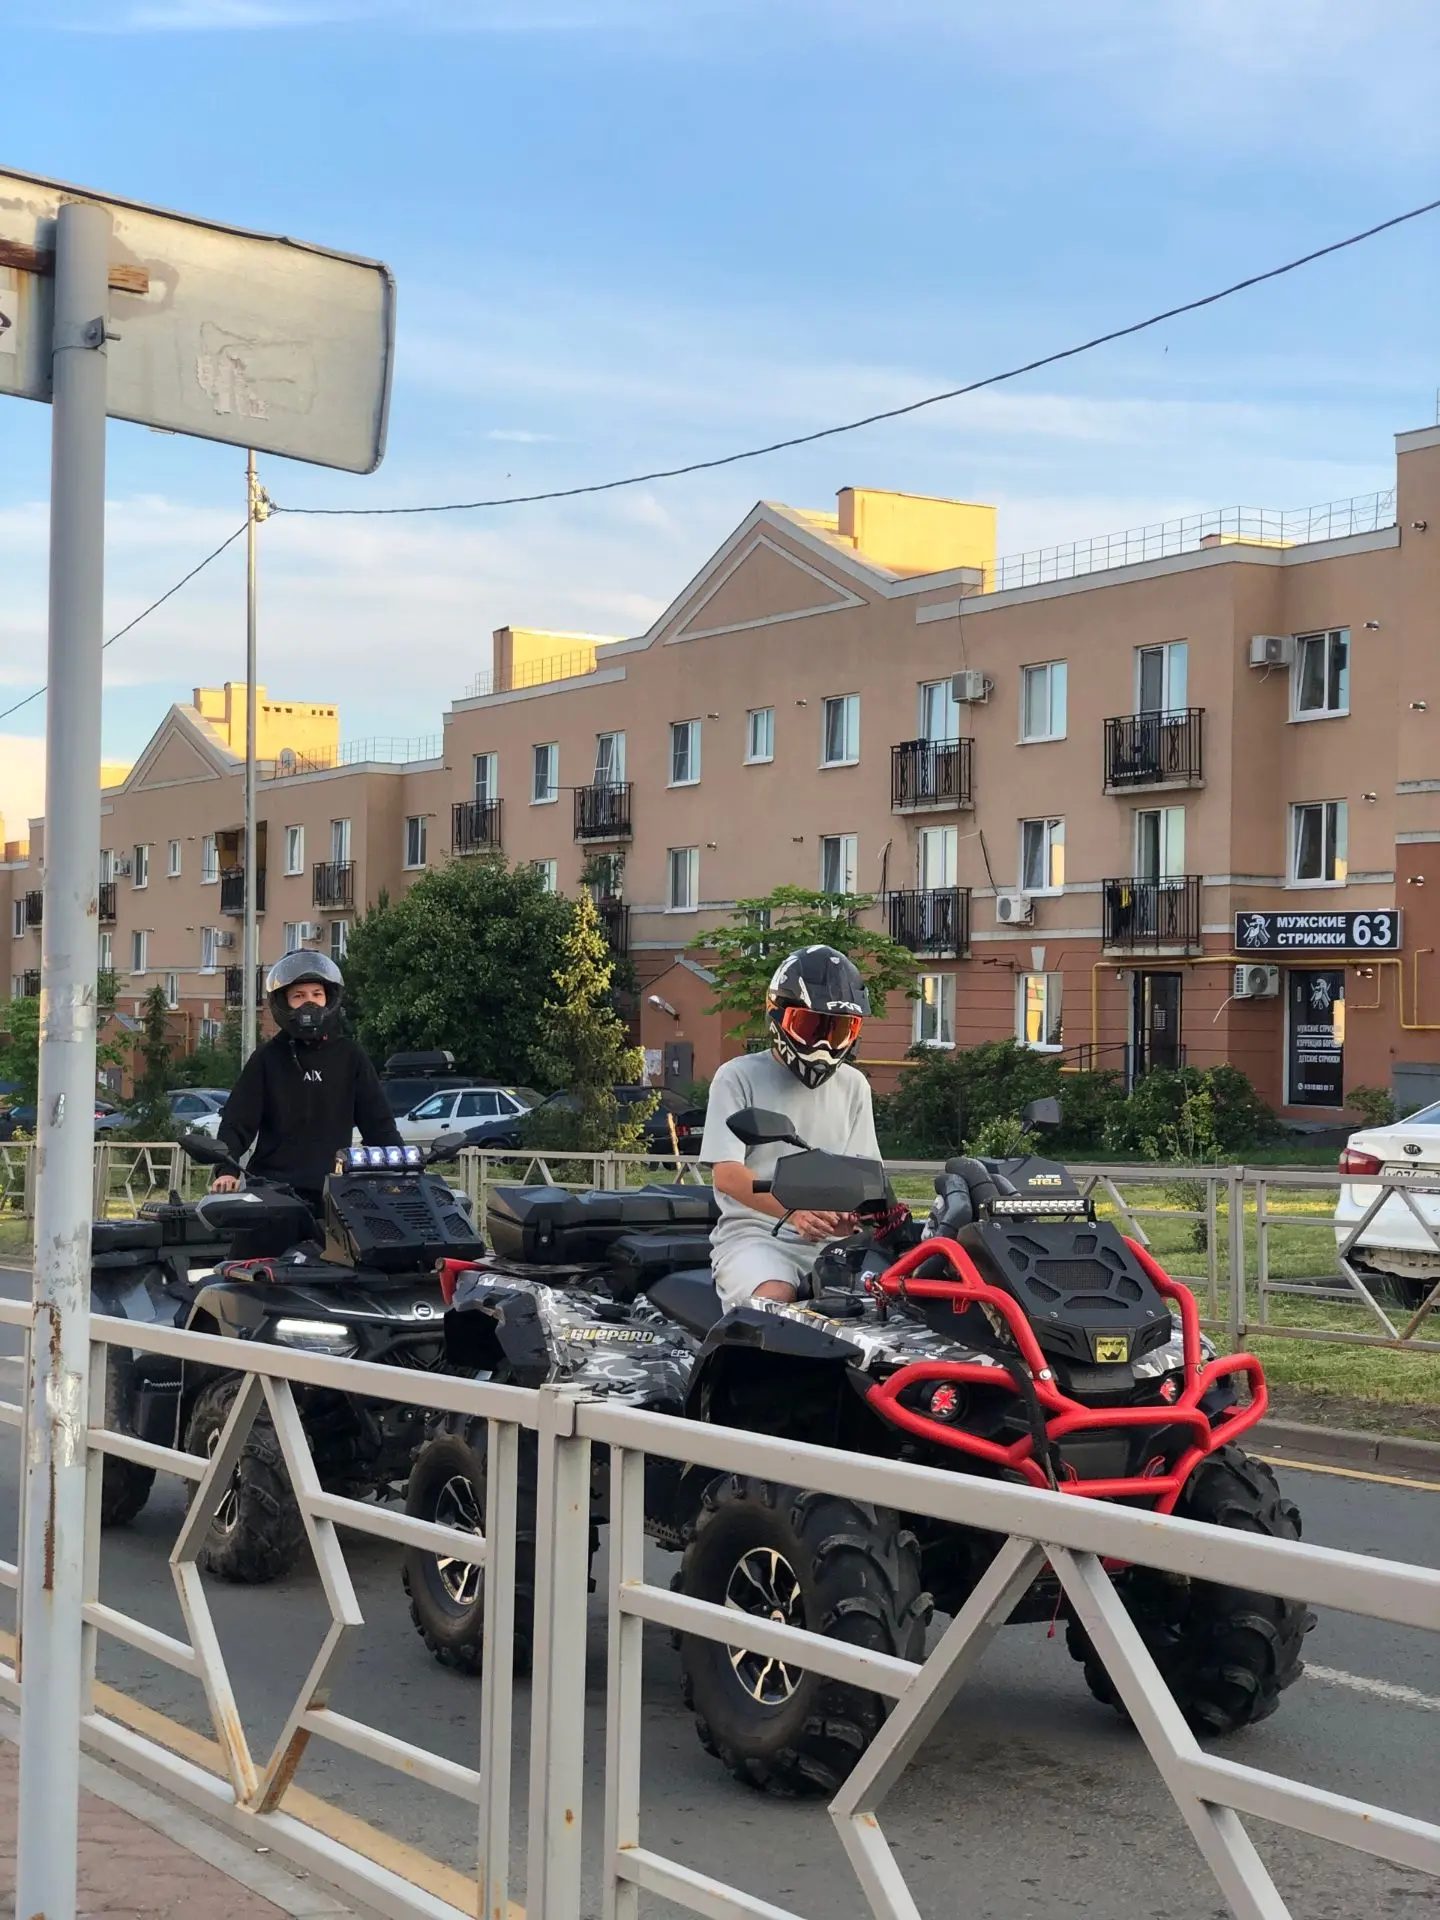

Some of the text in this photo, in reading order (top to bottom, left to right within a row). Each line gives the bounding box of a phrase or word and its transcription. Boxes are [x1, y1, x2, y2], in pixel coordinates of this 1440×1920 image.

[1276, 916, 1346, 928] МУЖСКИЕ
[1352, 914, 1391, 946] 63
[1277, 933, 1346, 945] СТРИЖКИ
[826, 1000, 863, 1014] FXR
[769, 1020, 797, 1065] FXR
[1405, 1144, 1421, 1155] KIA
[1028, 1178, 1062, 1186] STELS
[570, 1328, 654, 1343] GUEPARD
[670, 1348, 691, 1358] EPS
